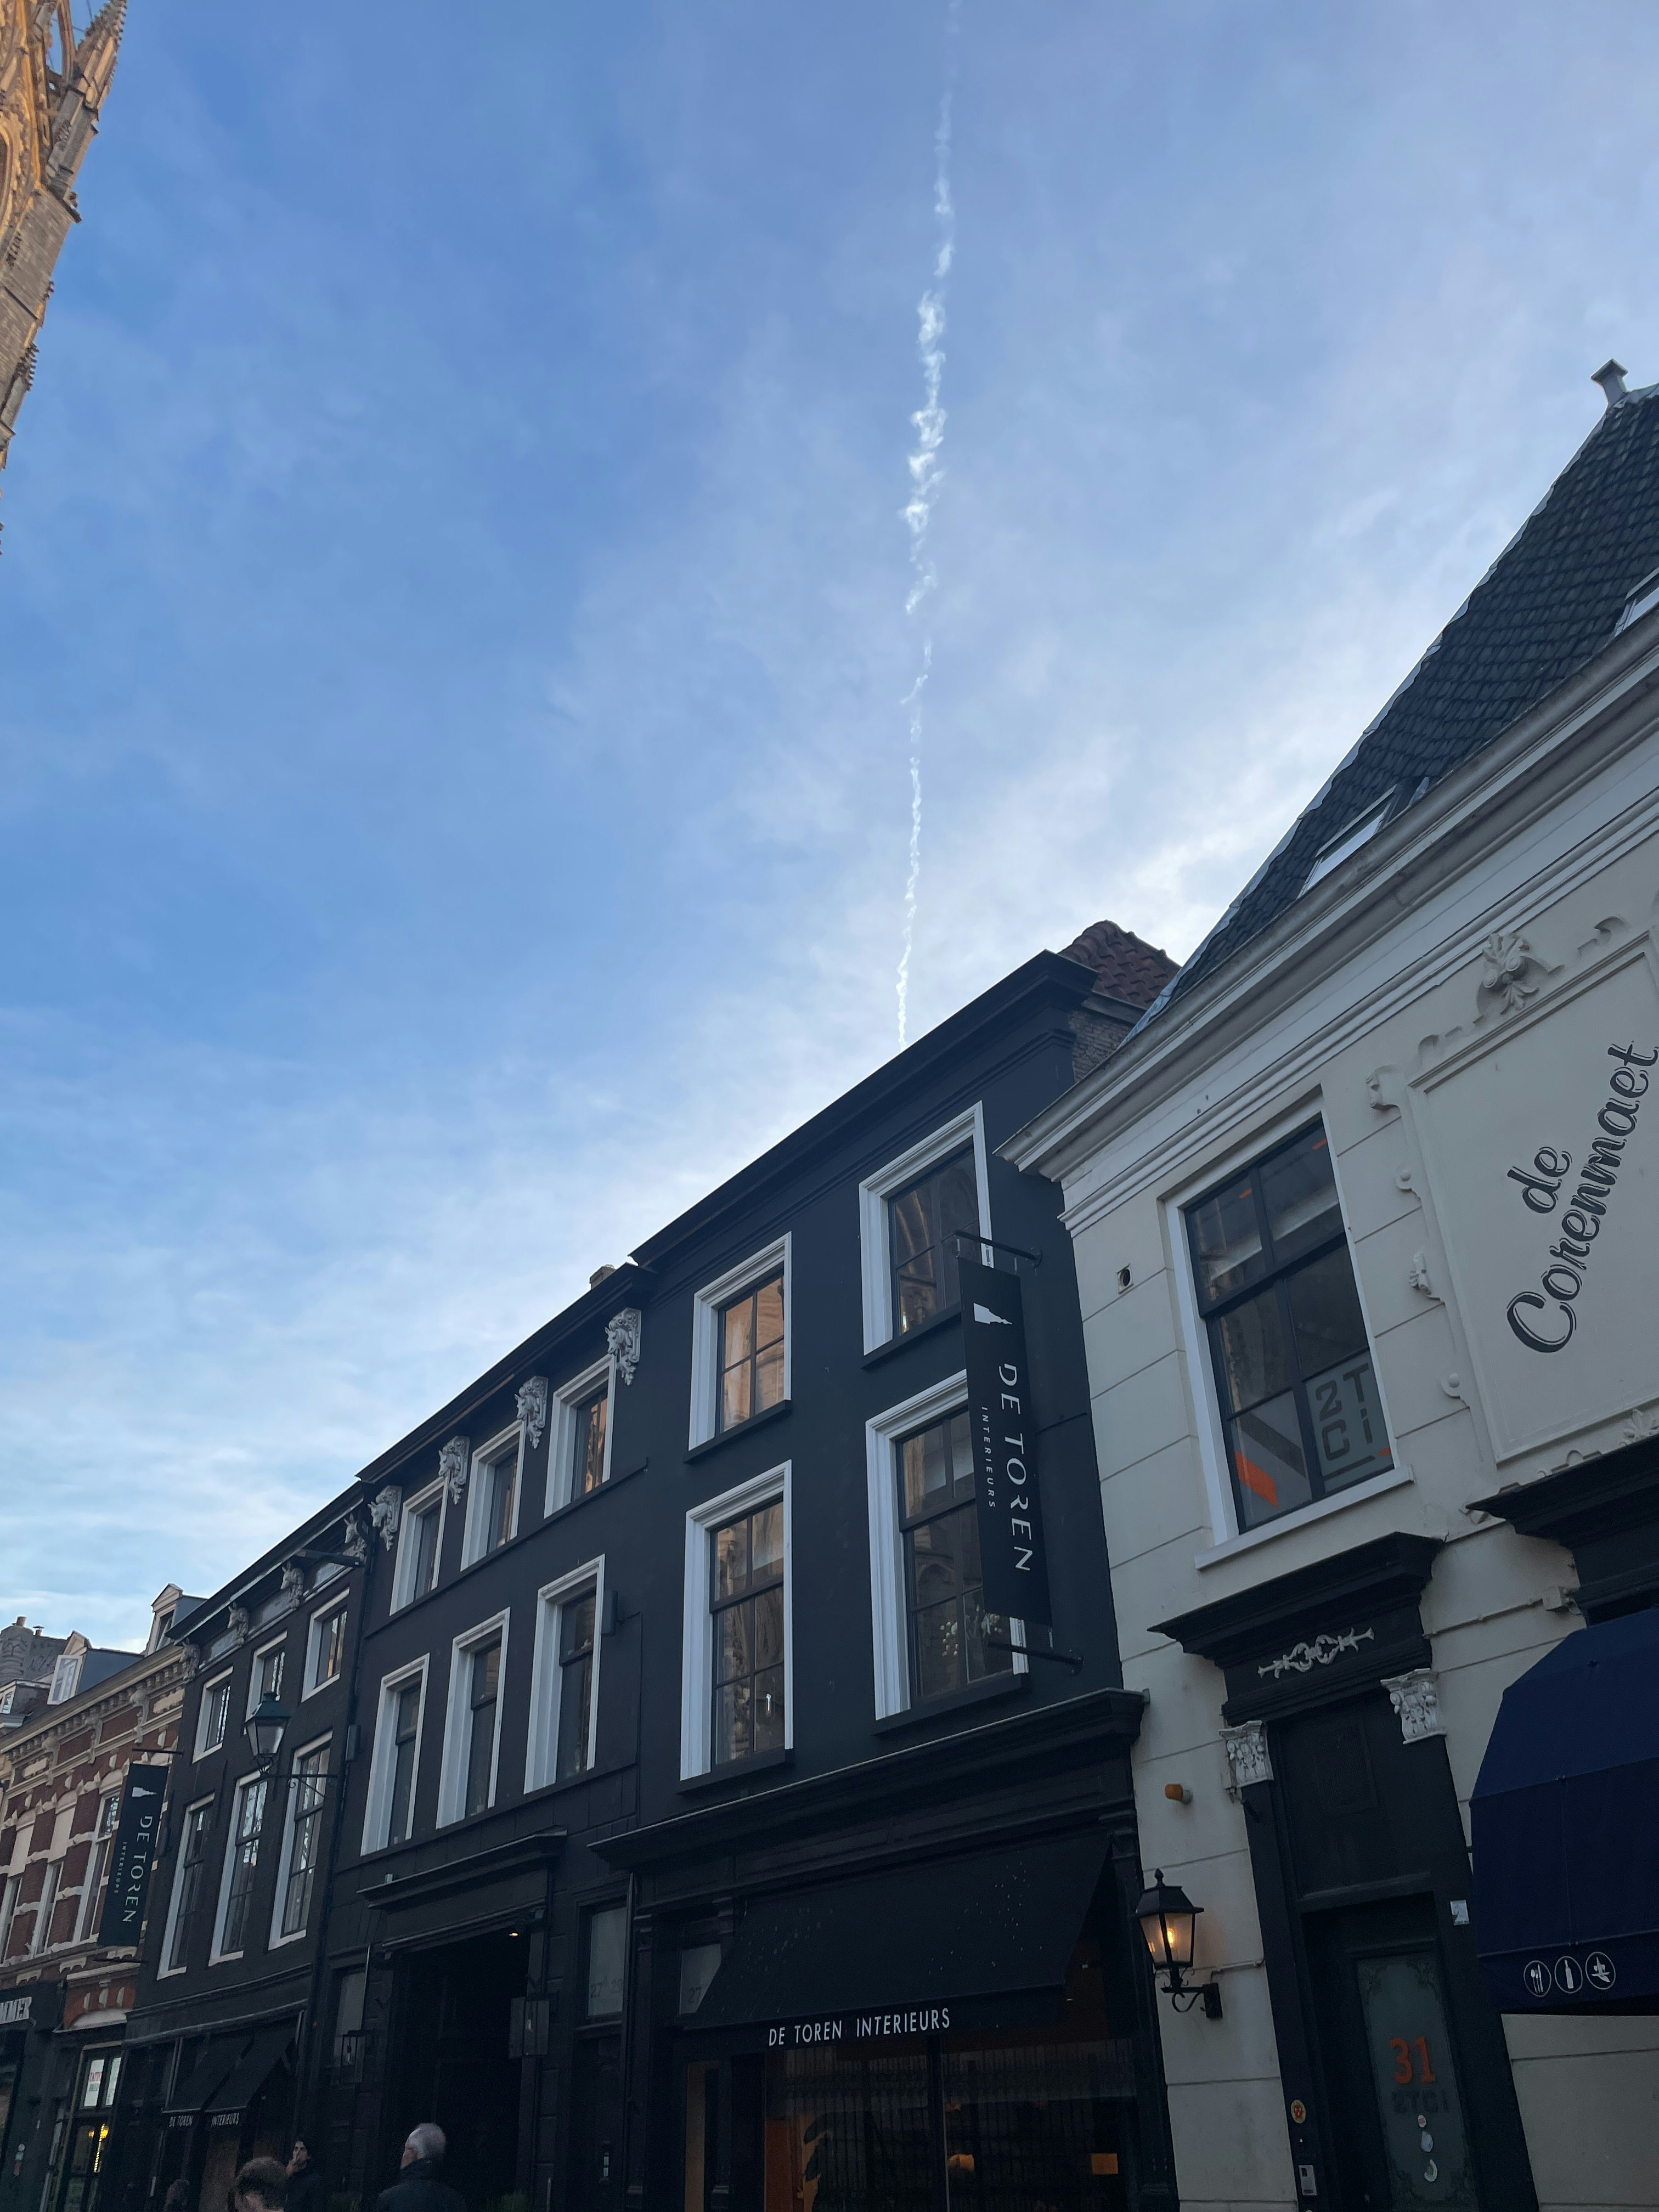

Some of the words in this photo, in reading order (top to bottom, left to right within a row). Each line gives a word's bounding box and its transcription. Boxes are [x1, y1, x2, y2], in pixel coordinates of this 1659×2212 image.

[1506, 1041, 1658, 1353] Corenmaet
[1507, 1147, 1572, 1214] de
[998, 1363, 1020, 1414] DE
[981, 1406, 996, 1508] INTERIEURS
[1005, 1433, 1034, 1571] TOREN
[136, 1815, 154, 1843] DE
[114, 1841, 127, 1894] INTERIEURS
[122, 1851, 148, 1922] TOREN
[769, 2027, 785, 2046] DE
[794, 2020, 842, 2044] TOREN
[856, 2008, 950, 2038] INTERIEURS
[1389, 2036, 1436, 2085] 31
[211, 2112, 240, 2128] INTERIEURS
